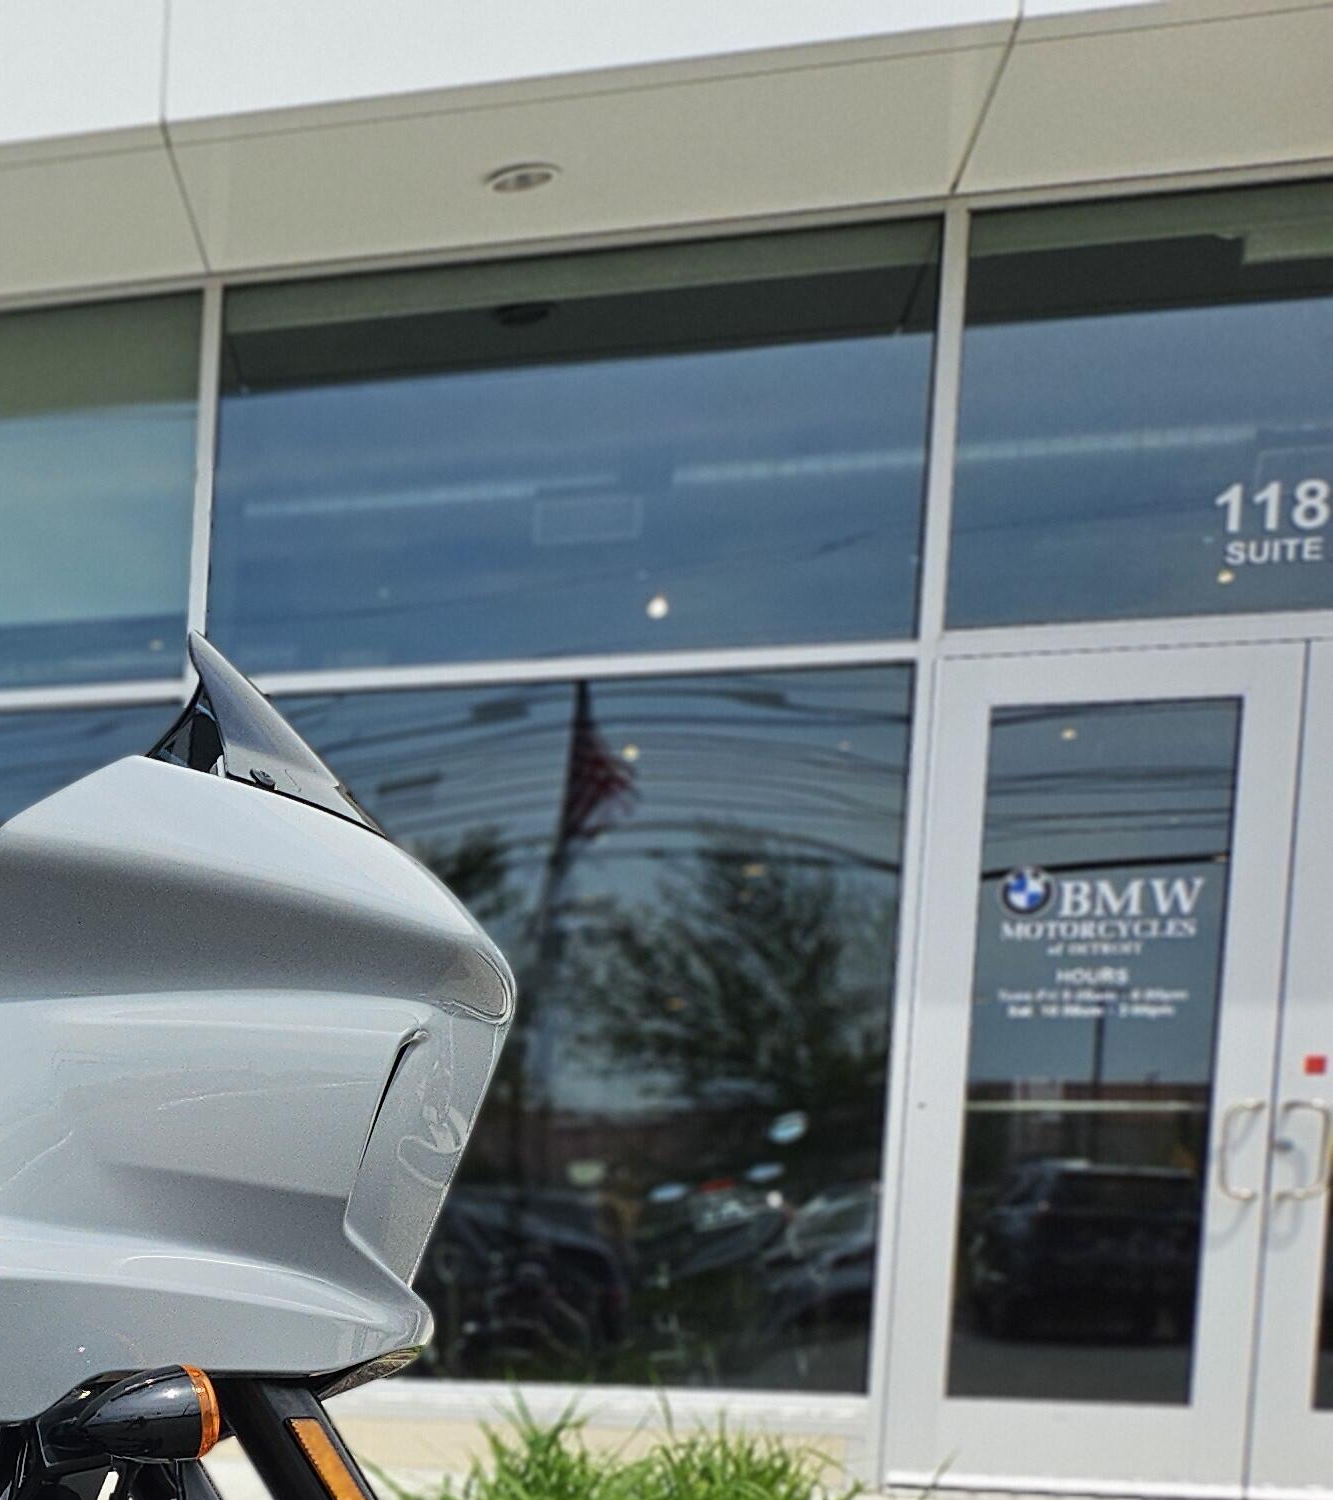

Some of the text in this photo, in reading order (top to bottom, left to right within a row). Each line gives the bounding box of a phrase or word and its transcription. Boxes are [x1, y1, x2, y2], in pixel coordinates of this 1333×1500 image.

[1225, 536, 1324, 566] SUITE
[1058, 876, 1205, 918] BMW
[1000, 918, 1198, 941] MOTORCYCLES
[1055, 967, 1129, 985] HOURS
